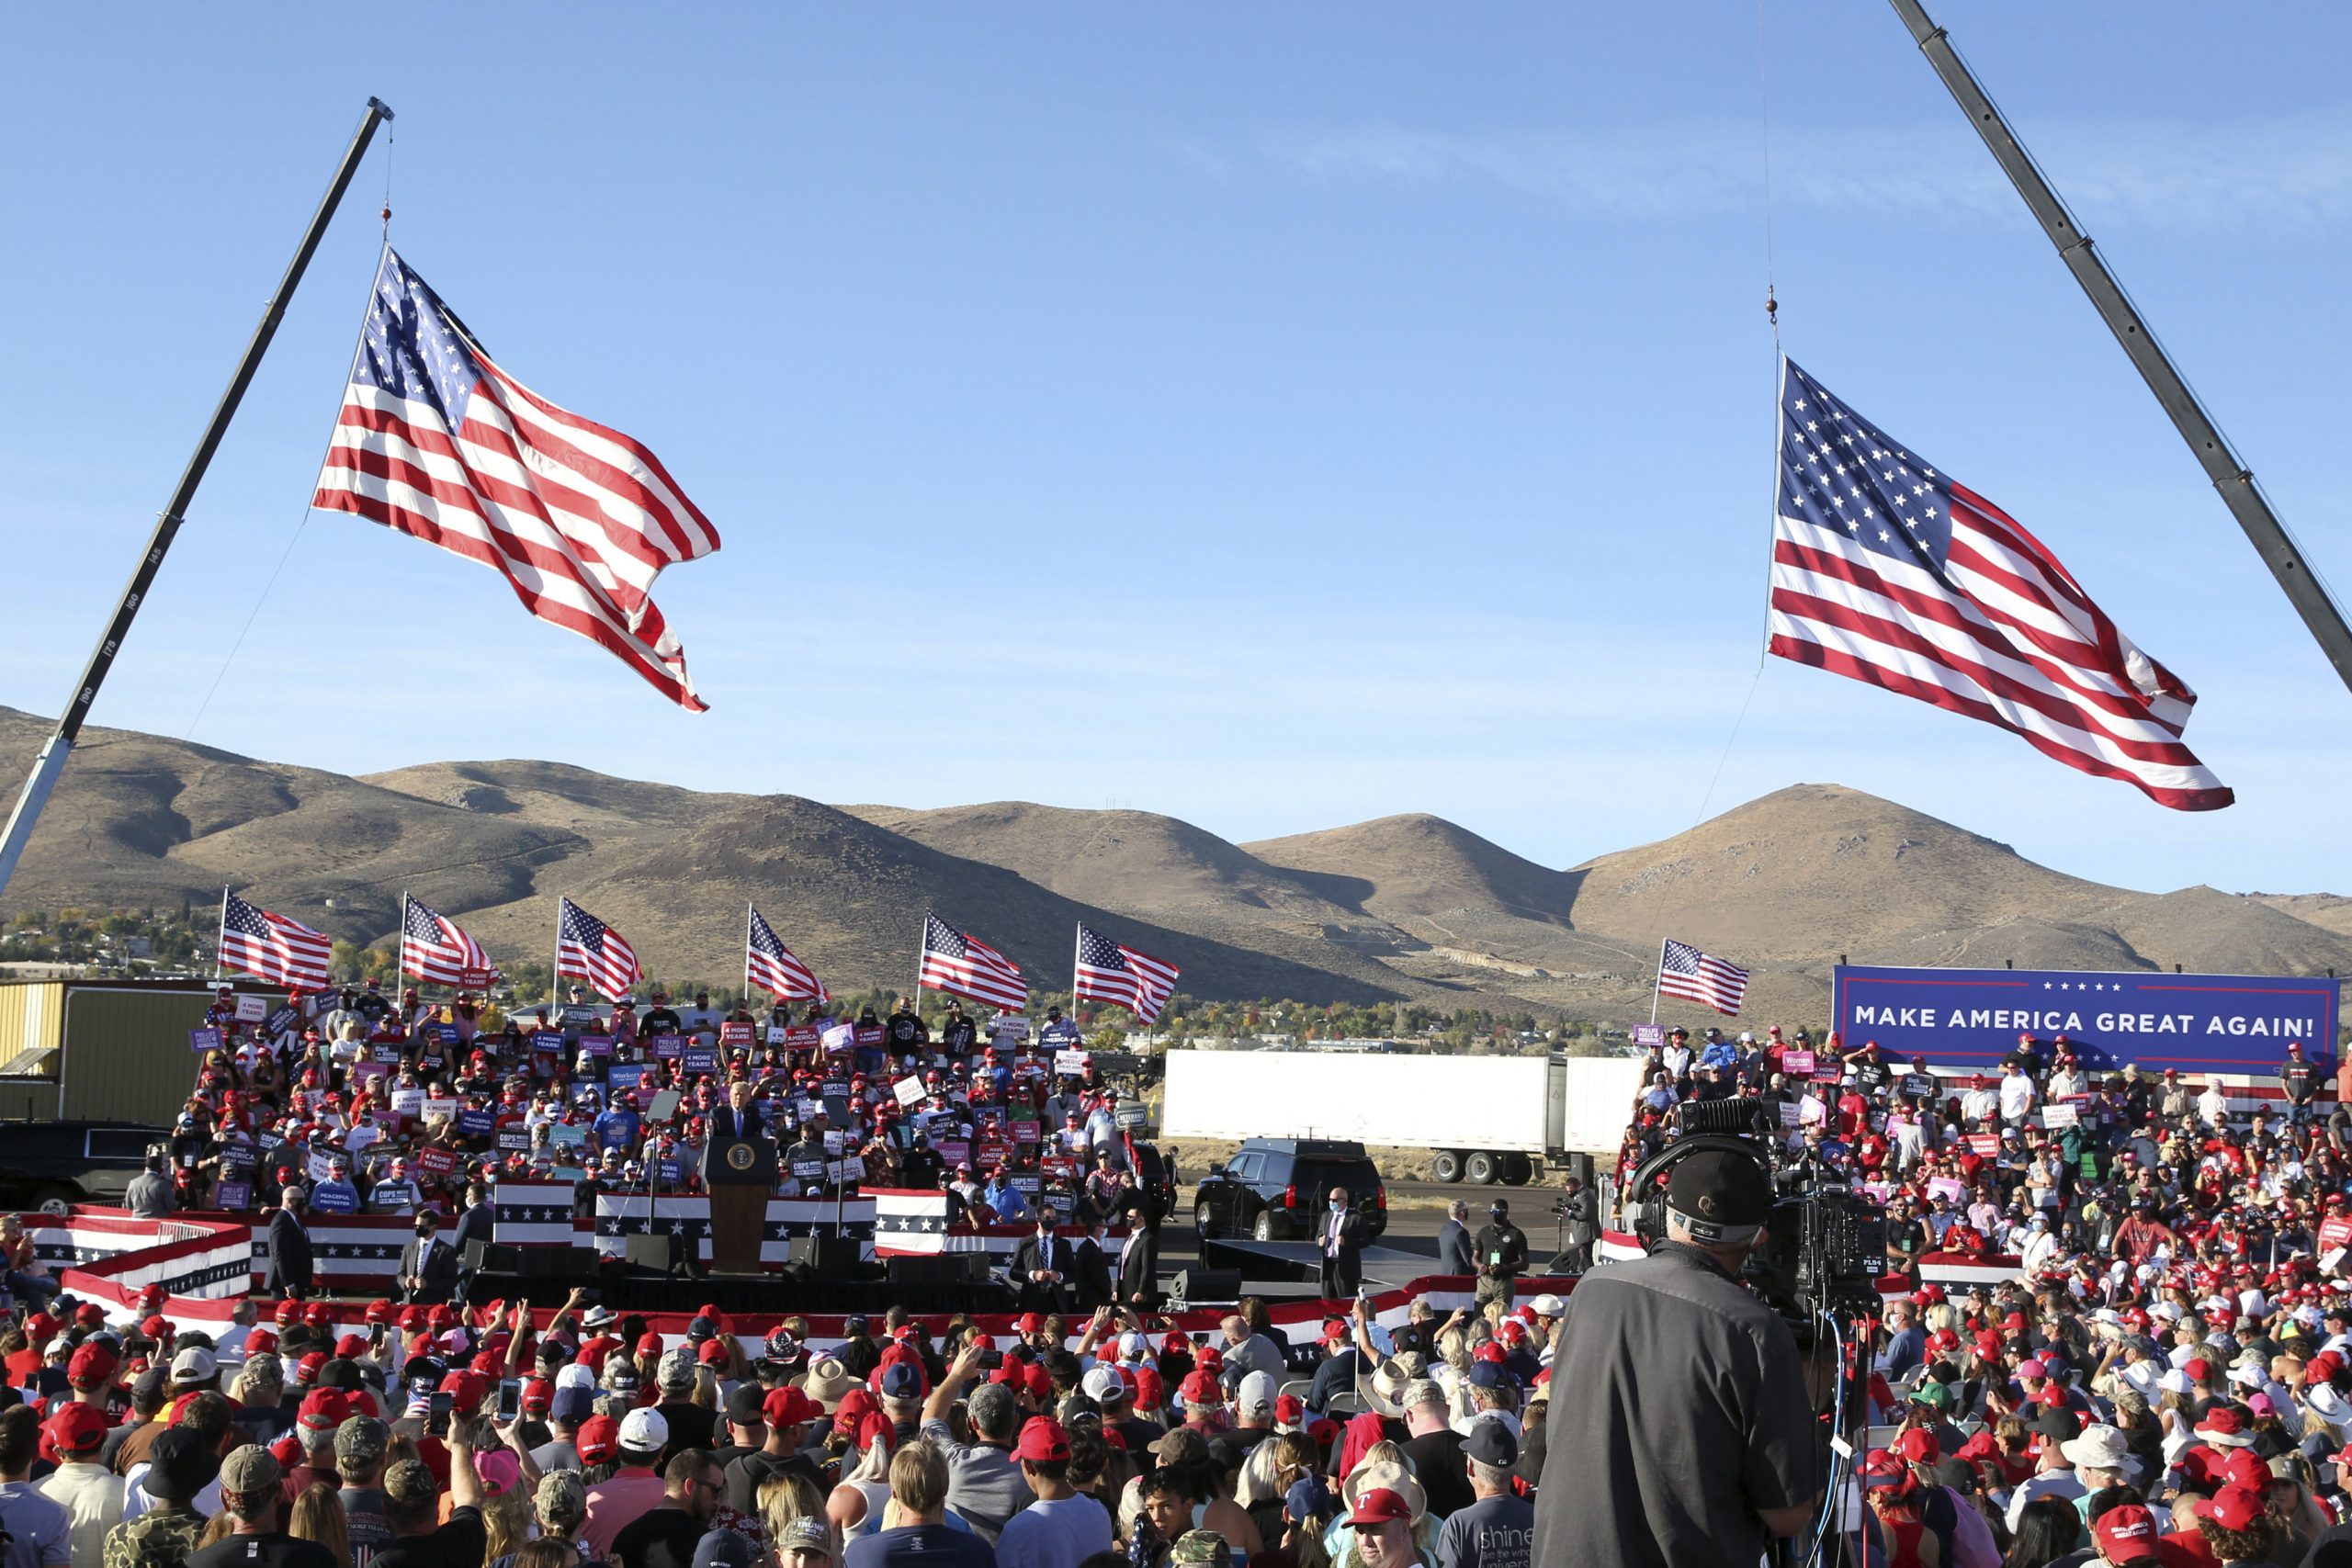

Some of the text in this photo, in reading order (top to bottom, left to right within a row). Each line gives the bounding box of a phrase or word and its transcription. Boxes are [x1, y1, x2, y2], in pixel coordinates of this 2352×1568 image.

[247, 1002, 264, 1010] MORE
[1855, 1005, 2314, 1038] MAKE AMERICA GREAT AGAIN!
[787, 1033, 817, 1042] AMERICA
[537, 1041, 560, 1049] YEARS!
[582, 1040, 609, 1049] Women
[465, 1115, 492, 1125] PEACEFUL
[1119, 1112, 1145, 1122] VETERANS
[499, 1134, 515, 1142] COPS
[221, 1151, 255, 1160] AMERICA
[939, 1148, 965, 1157] Women
[430, 1154, 452, 1164] MORE
[424, 1159, 449, 1171] YEARS!
[793, 1162, 809, 1170] COPS
[1011, 1177, 1026, 1185] COPS
[379, 1190, 396, 1198] COPS
[1358, 1493, 1372, 1509] T
[797, 1521, 825, 1531] TRUMP
[1481, 1525, 1533, 1549] shine
